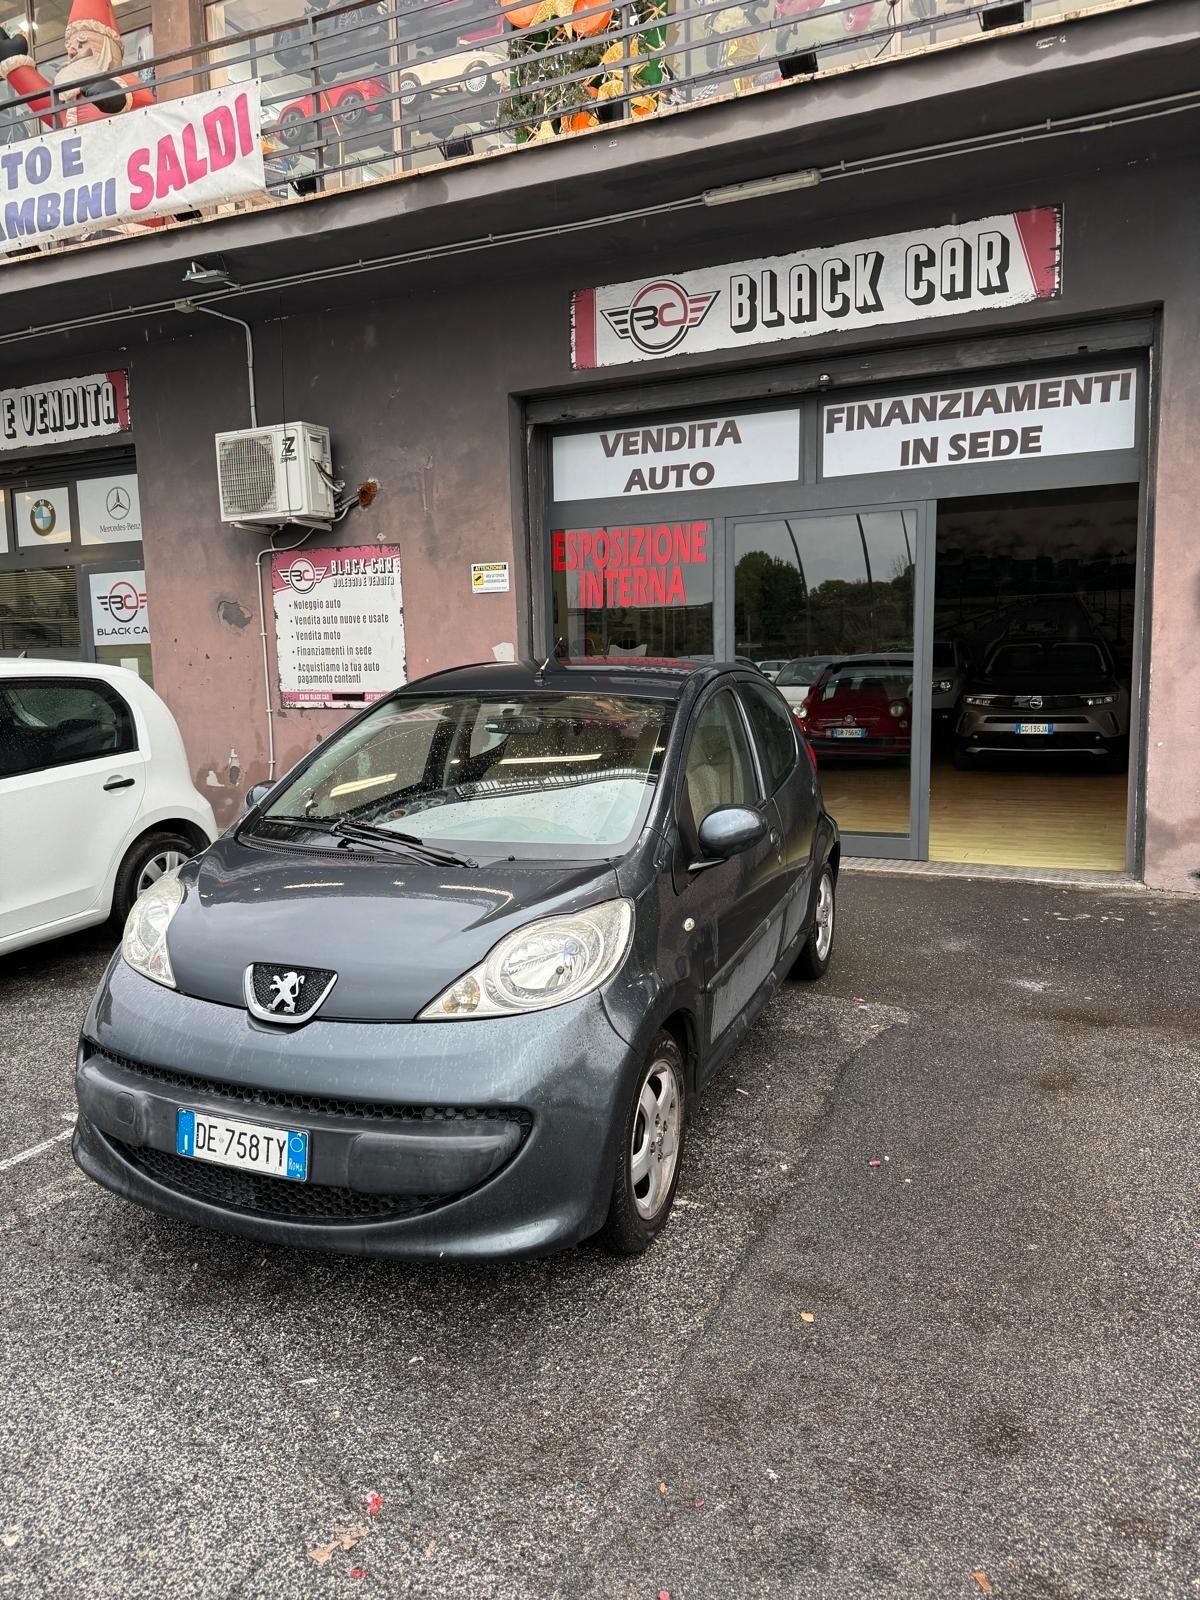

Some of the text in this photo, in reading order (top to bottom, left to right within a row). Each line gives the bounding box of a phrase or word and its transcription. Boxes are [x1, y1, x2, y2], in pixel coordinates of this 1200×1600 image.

[61, 136, 84, 178] E
[127, 93, 253, 211] SALDI
[729, 250, 884, 333] BLACK
[905, 230, 1010, 305] CAR
[2, 381, 118, 439] E VENDITA
[825, 371, 1132, 434] FINANZIAMENTI
[600, 419, 742, 459] VENDITA
[899, 425, 1044, 468] IN SEDE
[622, 460, 715, 494] AUTO
[99, 523, 141, 533] Mercedes-Benz
[551, 519, 708, 572] ESPOSIZIONE
[330, 558, 367, 576] BLACK
[371, 557, 394, 574] CAR
[333, 576, 395, 588] NOLEGGIO E VENDITA
[578, 566, 687, 608] INTERNA
[294, 599, 341, 610] Noleggio auto
[295, 614, 389, 625] Vendita auto nuove e usate
[97, 627, 131, 636] BLACK
[296, 630, 341, 641] Vendita moto
[297, 645, 372, 656] Finanziamenti in sede
[298, 662, 380, 673] Acquistiamo la tua auto
[297, 673, 361, 684] pagamento contanti
[196, 1122, 218, 1153] DE
[224, 1128, 287, 1167] 758TY
